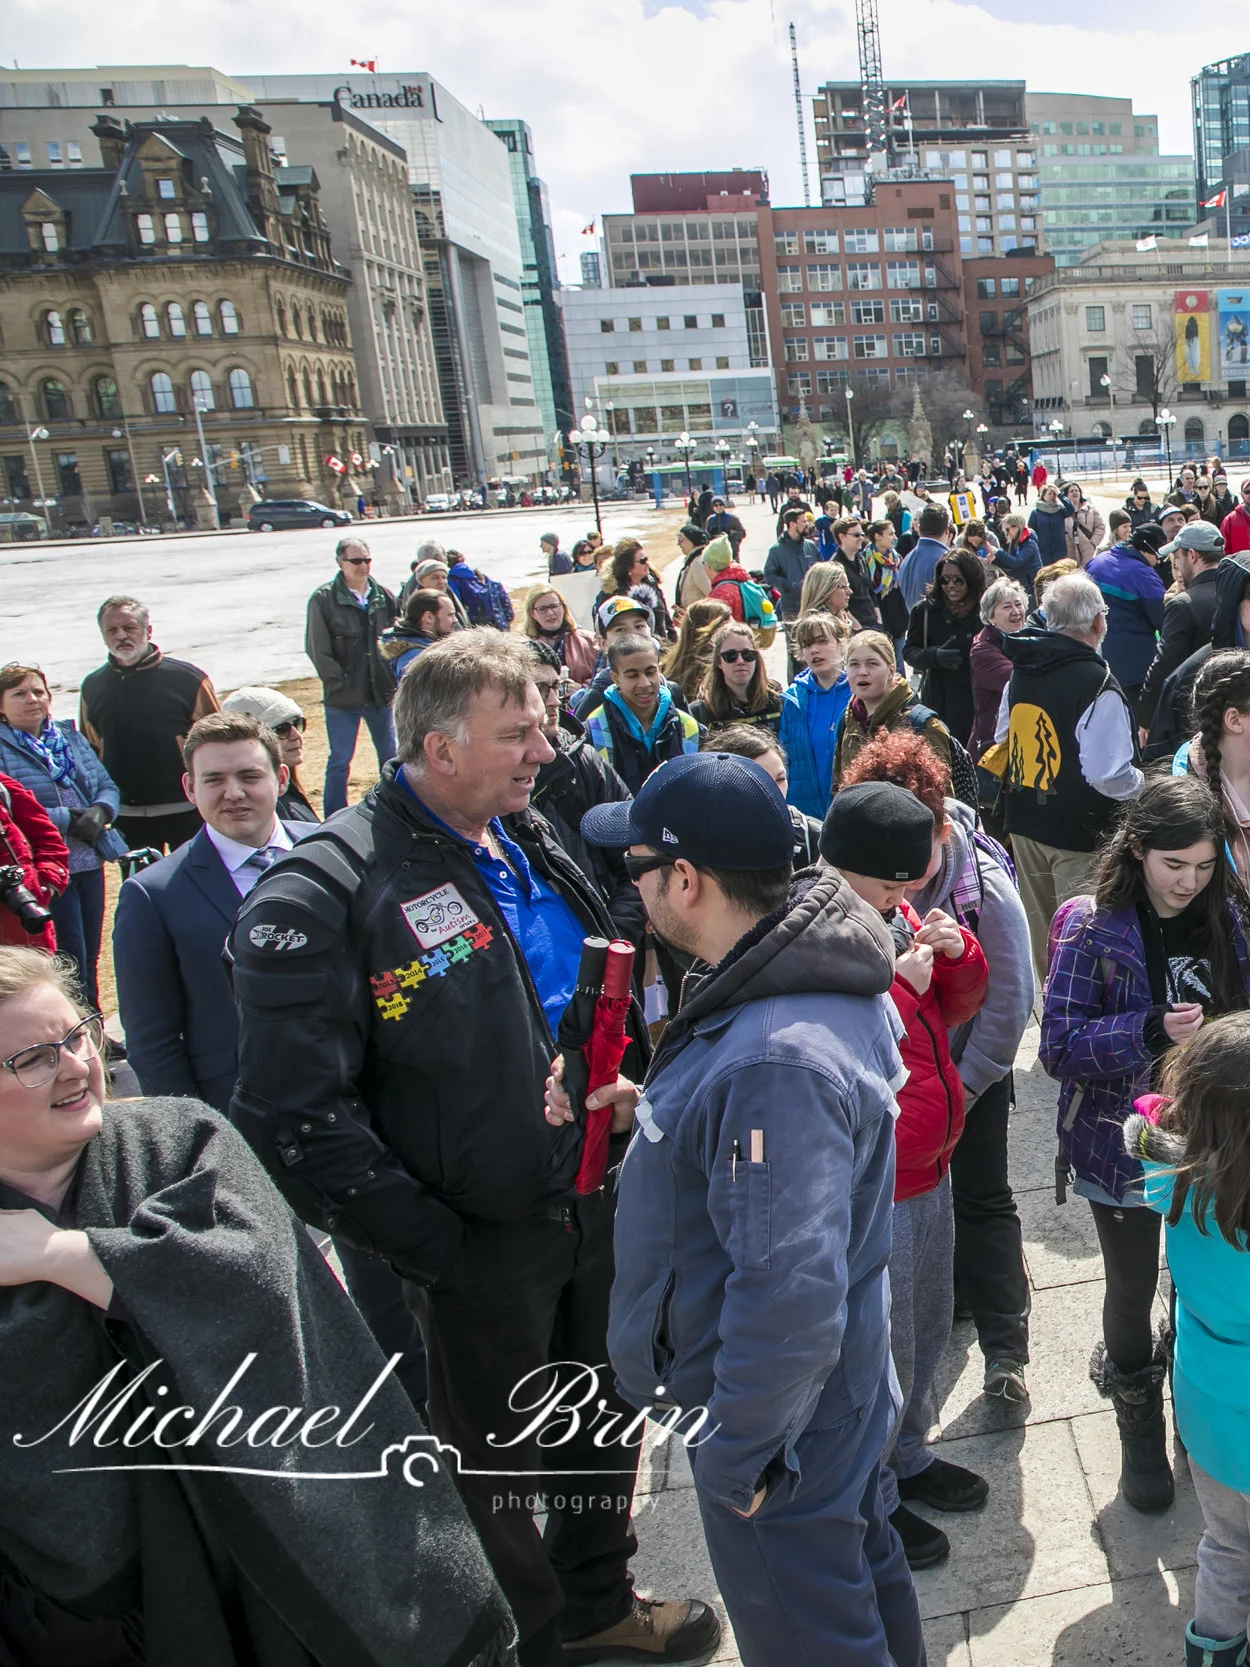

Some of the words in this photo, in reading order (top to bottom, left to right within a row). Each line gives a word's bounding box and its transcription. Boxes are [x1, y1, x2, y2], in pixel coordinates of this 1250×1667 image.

[333, 85, 424, 109] Canada
[404, 888, 449, 913] MOTORCYCLE
[439, 913, 471, 934] Autism
[262, 932, 305, 943] ROCKET
[453, 944, 468, 955] 2016
[431, 956, 446, 967] 2015
[405, 968, 423, 979] 2014
[388, 1001, 404, 1011] 2018
